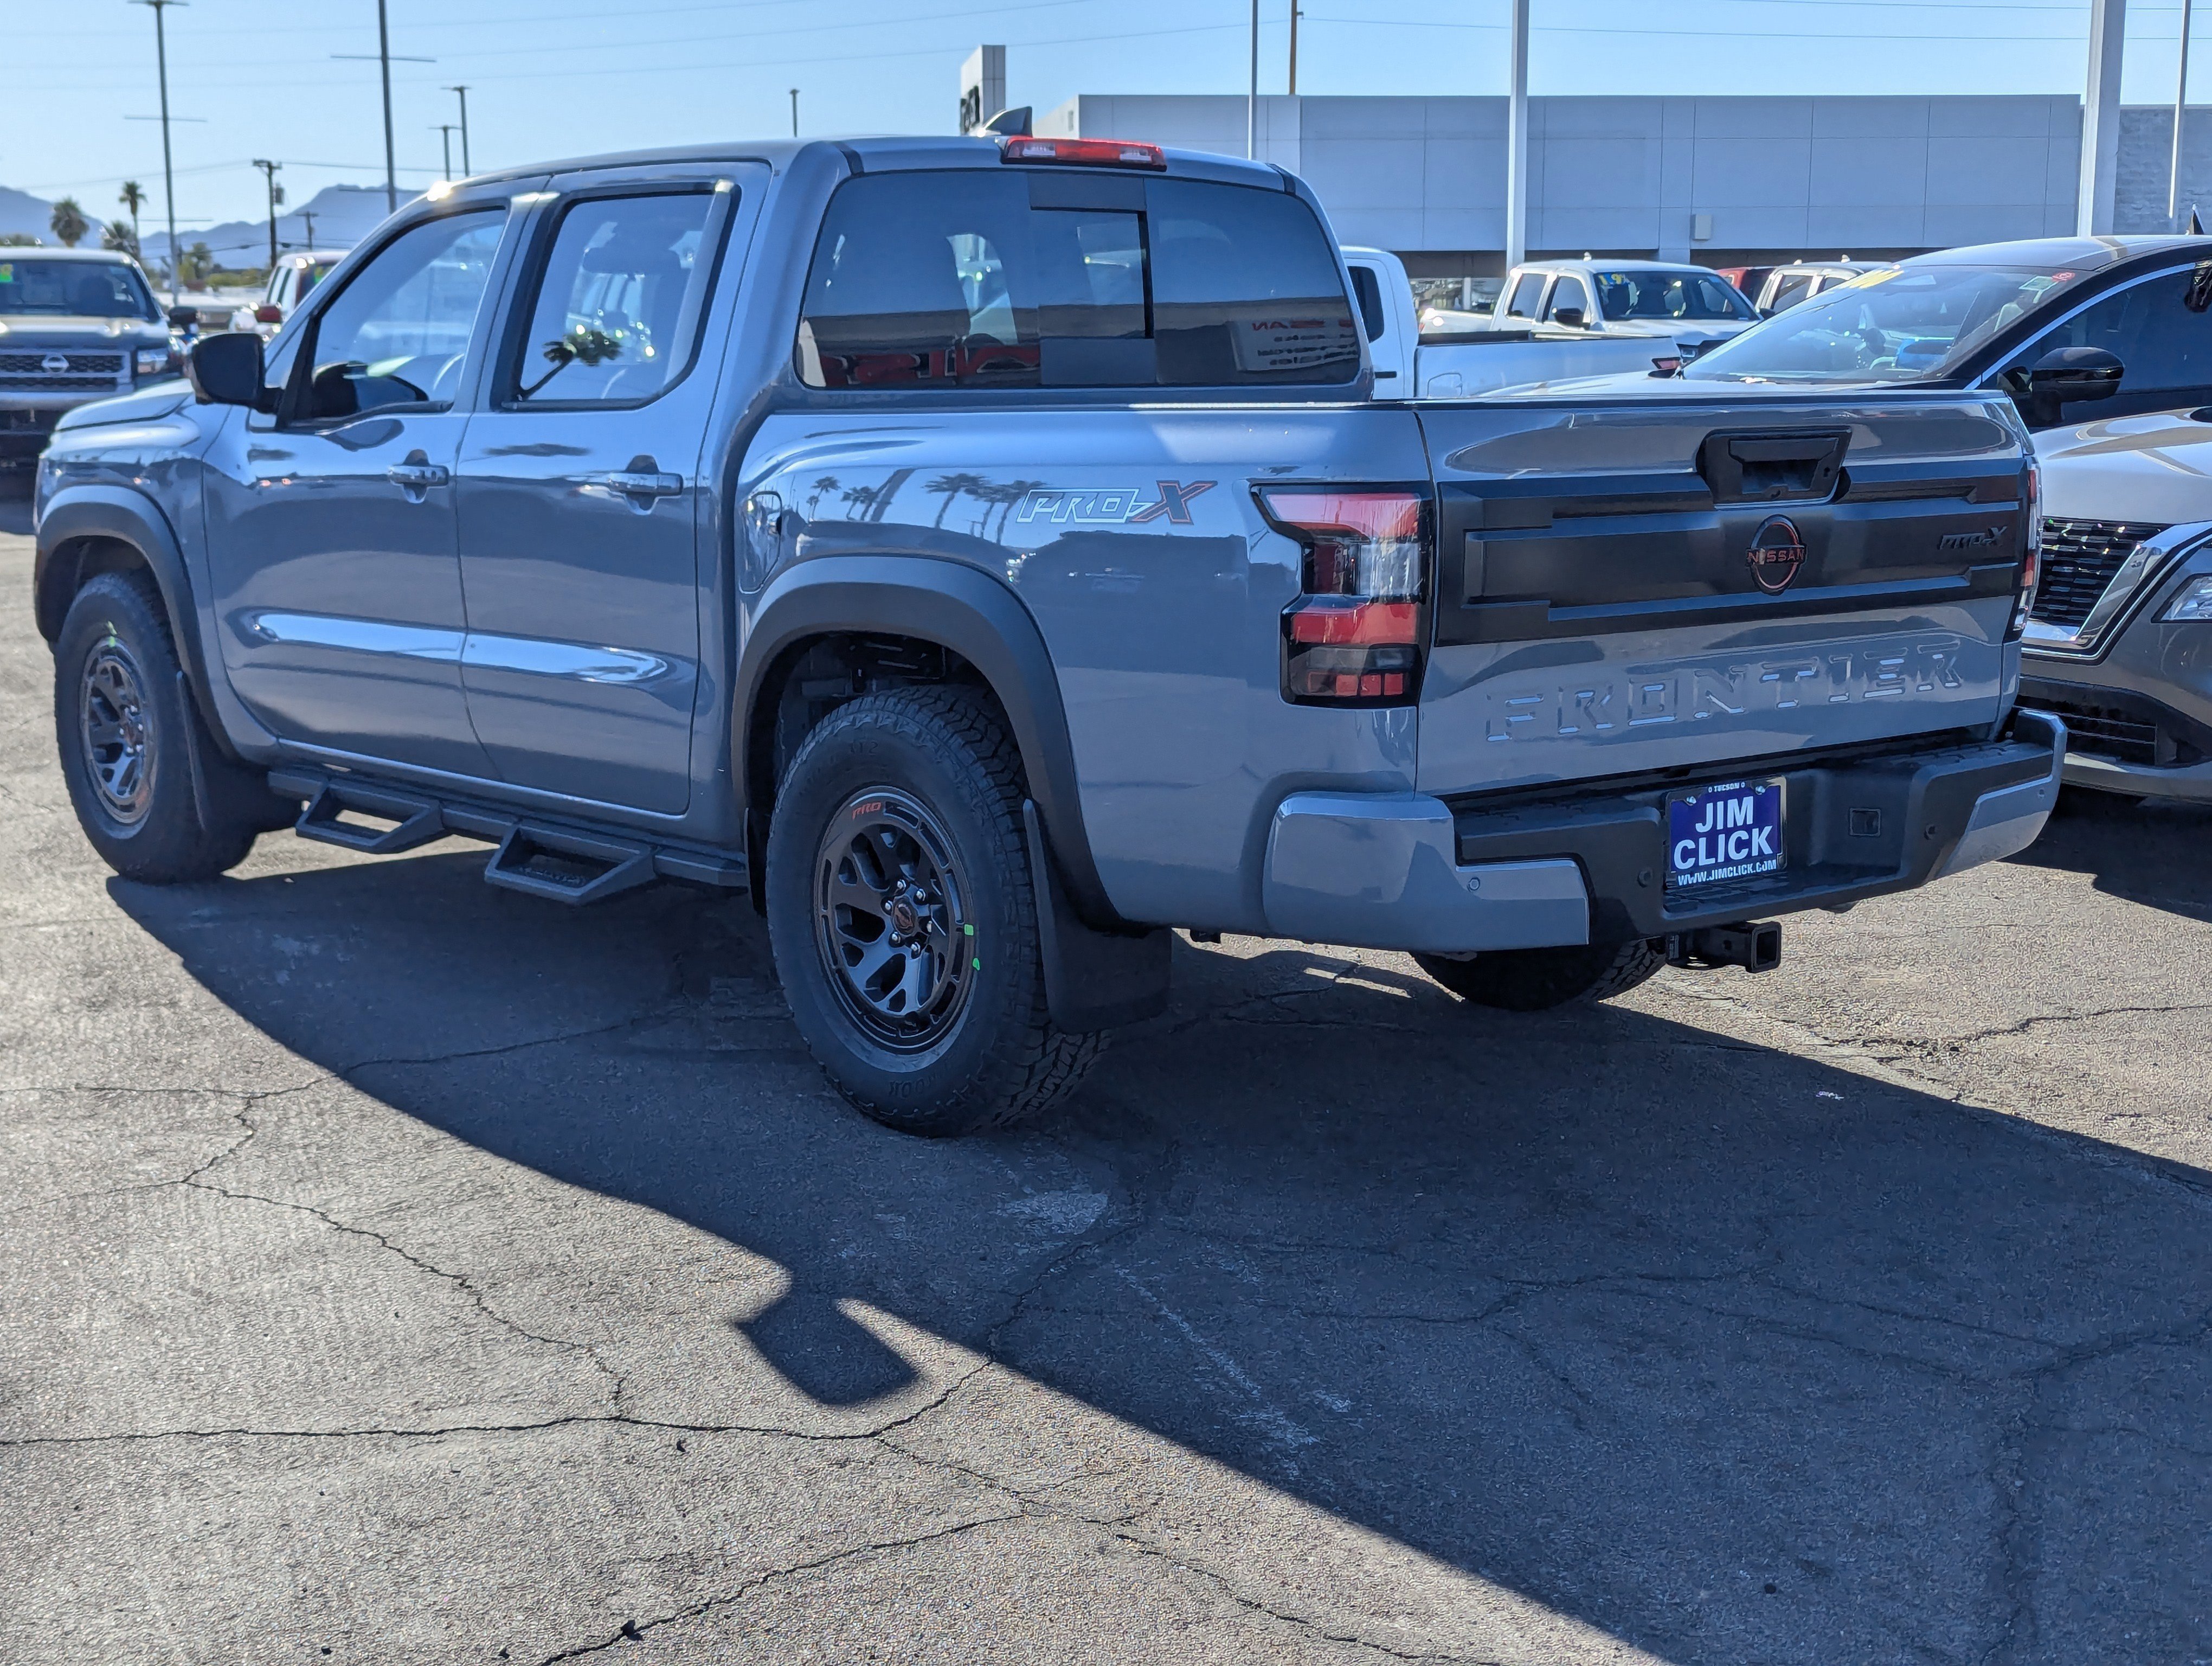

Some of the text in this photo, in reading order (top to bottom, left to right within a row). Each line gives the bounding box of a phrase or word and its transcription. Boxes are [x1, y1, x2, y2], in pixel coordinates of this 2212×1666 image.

[1016, 479, 1218, 525] PRO-X
[1746, 547, 1805, 564] NISSAN
[1485, 638, 1963, 742] FRONTIER
[1714, 782, 1740, 792] TUCSON
[1695, 796, 1754, 832] JIM
[1674, 825, 1773, 870] CLICK
[1678, 859, 1777, 886] WWW.JIMCLICK.COM
